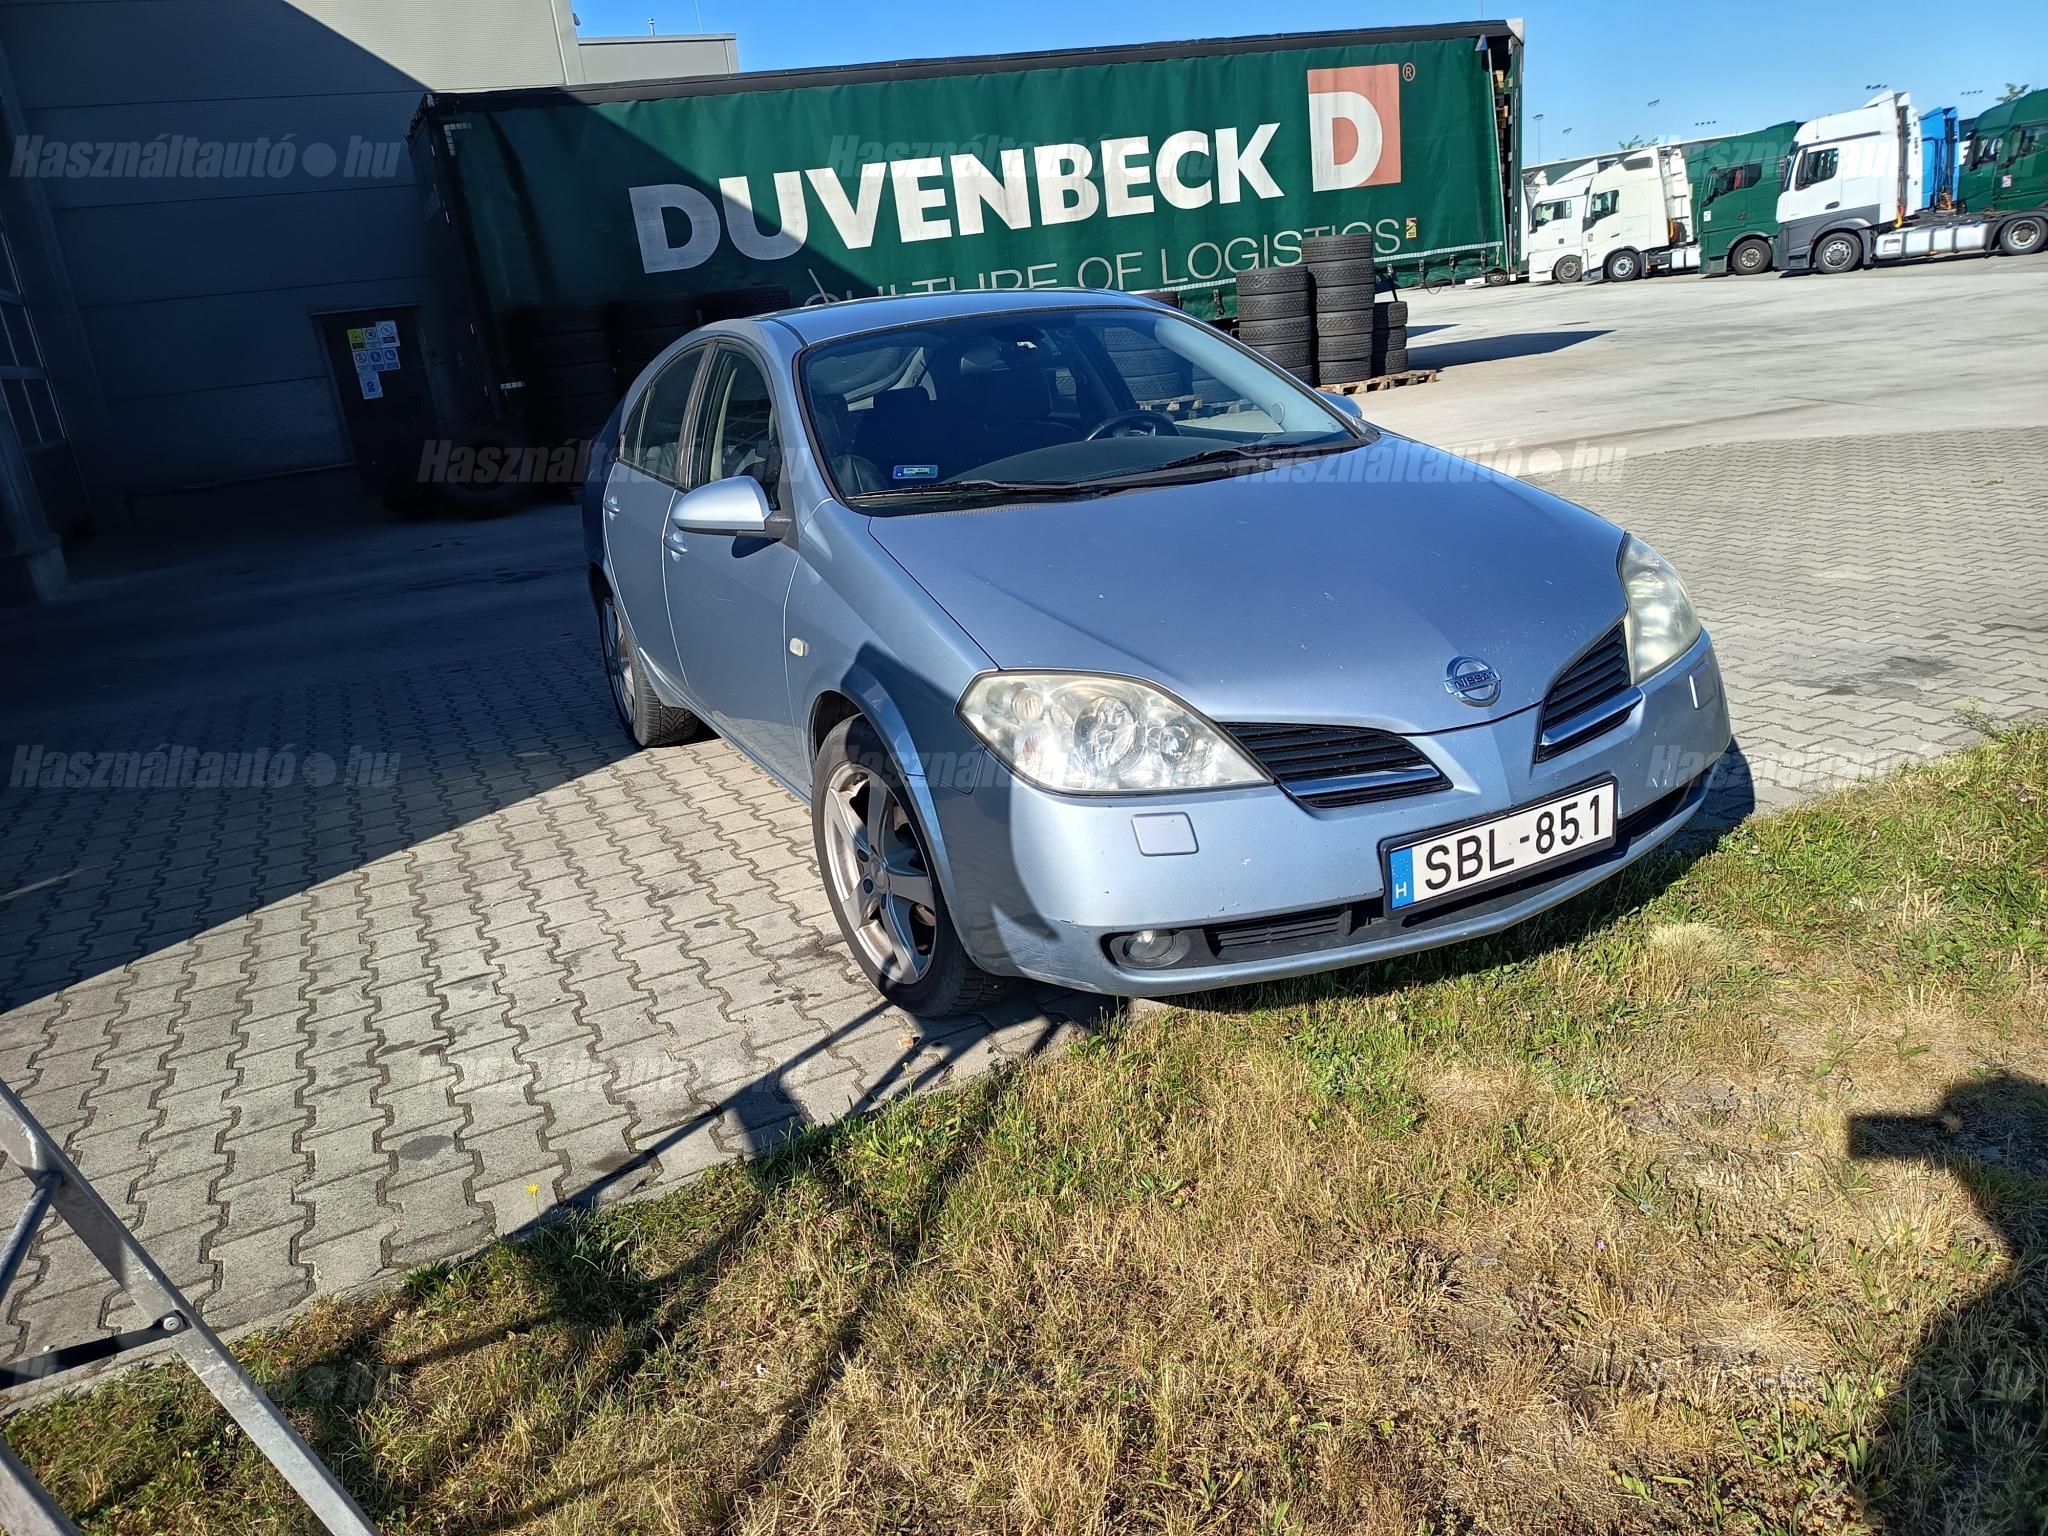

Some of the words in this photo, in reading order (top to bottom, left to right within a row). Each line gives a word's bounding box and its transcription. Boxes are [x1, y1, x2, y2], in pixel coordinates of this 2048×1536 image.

[1309, 91, 1383, 192] D
[628, 122, 1285, 274] DUVENBECK
[1077, 251, 1143, 290] OF
[1160, 218, 1400, 285] LOGISS
[1453, 667, 1500, 688] NISSAN
[1425, 794, 1600, 891] SBL-851
[1394, 884, 1407, 900] H
